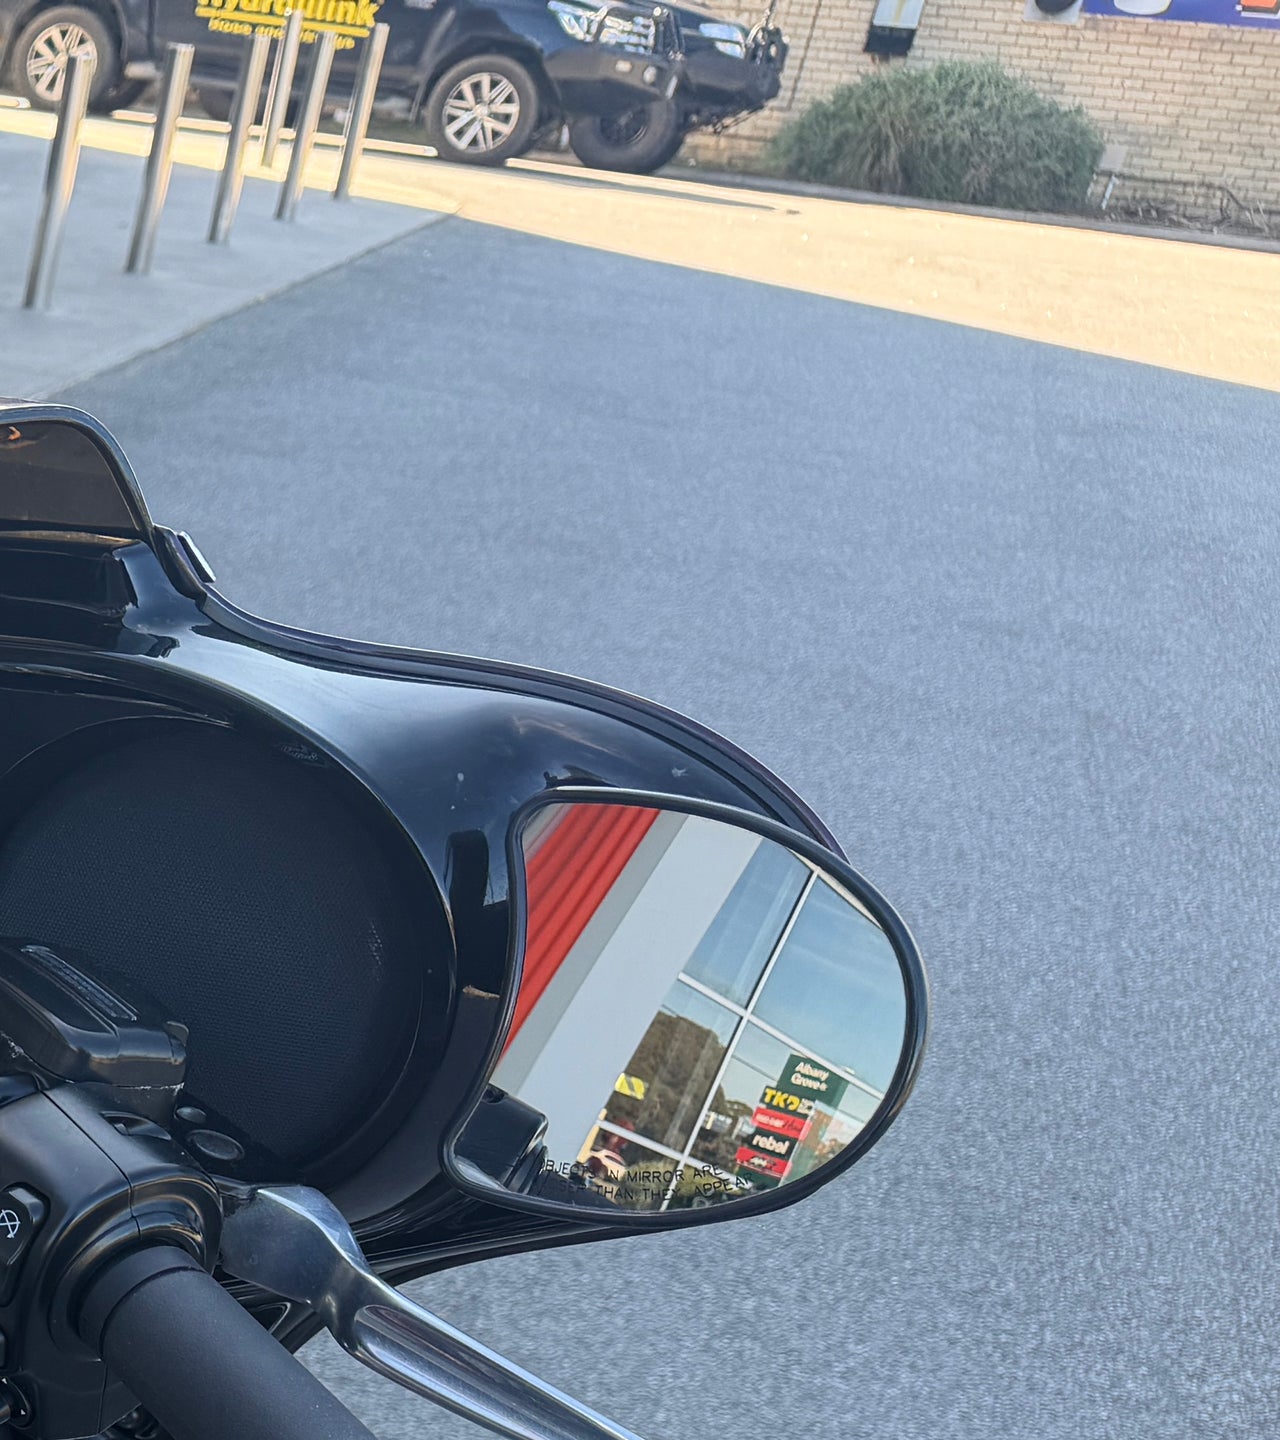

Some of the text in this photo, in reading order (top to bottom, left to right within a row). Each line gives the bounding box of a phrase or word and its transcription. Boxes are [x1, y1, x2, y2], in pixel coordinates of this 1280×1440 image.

[627, 1169, 685, 1183] MIRROR
[693, 1164, 724, 1180] ARE
[597, 1185, 635, 1201] THAN
[644, 1187, 682, 1201] THEY
[694, 1173, 754, 1199] APPEAR
